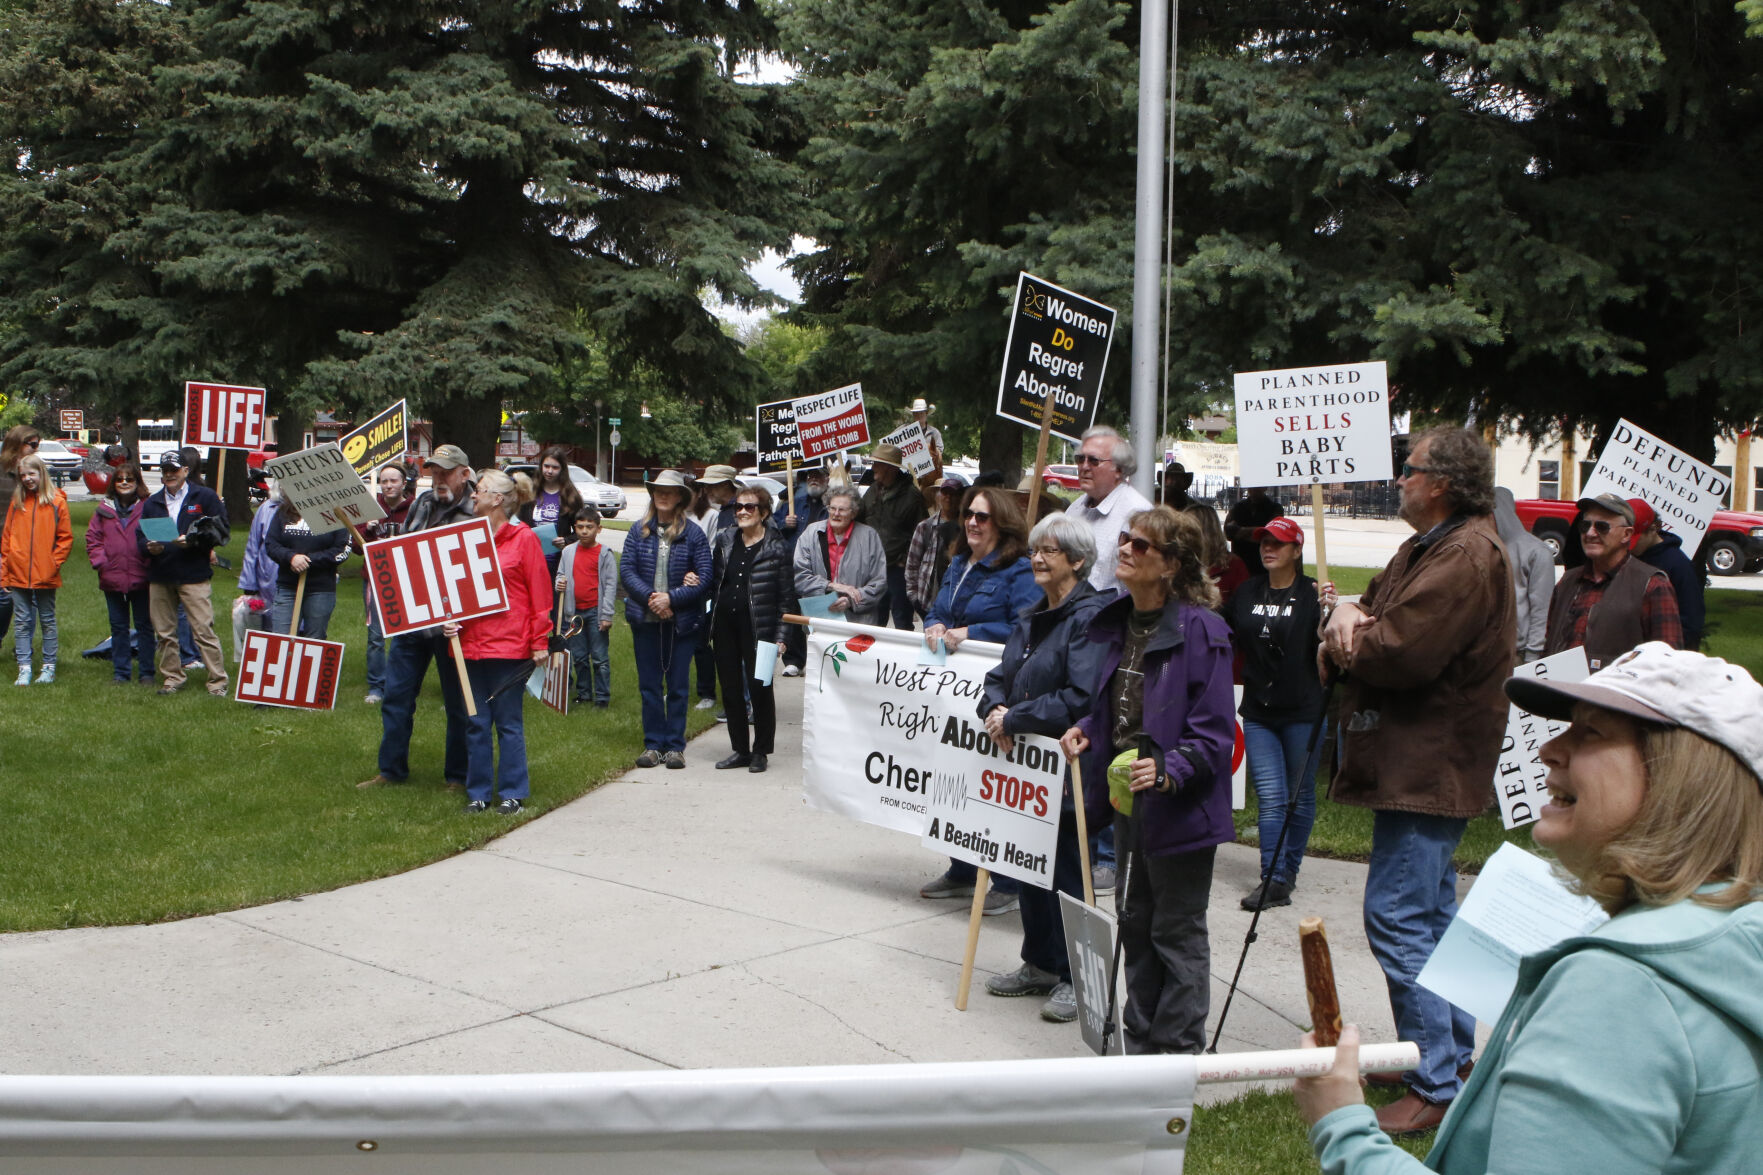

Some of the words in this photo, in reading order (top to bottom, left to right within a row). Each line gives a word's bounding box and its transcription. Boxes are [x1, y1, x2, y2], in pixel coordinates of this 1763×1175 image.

[1046, 295, 1107, 338] Women
[1052, 327, 1074, 351] Do
[1028, 342, 1084, 381] Regret
[1261, 370, 1361, 390] PLANNED
[796, 396, 836, 417] RESPECT
[839, 388, 860, 404] LIFE
[1014, 369, 1085, 412] Abortion
[1244, 390, 1380, 412] PARENTHOOD
[188, 388, 200, 441] CHOOSE
[200, 389, 262, 446] LIFE
[368, 411, 403, 450] SMILE!
[770, 422, 798, 435] Regr
[778, 408, 794, 420] Me
[801, 426, 822, 441] FROM
[823, 421, 838, 435] THE
[838, 413, 864, 430] WOMB
[1274, 412, 1351, 433] SELLS
[758, 447, 803, 462] Fatherh
[811, 442, 821, 453] TO
[823, 437, 837, 449] THE
[837, 431, 860, 446] TOMB
[901, 439, 924, 458] STOPS
[1281, 436, 1346, 455] BABY
[1613, 425, 1726, 497] DEFUND
[271, 448, 344, 480] DEFUND
[294, 471, 344, 492] PLANNED
[1276, 457, 1355, 478] PARTS
[1623, 456, 1698, 504] PLANNED
[295, 484, 367, 510] PARENTHOOD
[320, 503, 362, 526] NW
[1598, 465, 1706, 531] PARENTHOOD
[373, 548, 401, 627] CHOOSE
[391, 527, 501, 625] LIFE
[241, 635, 324, 704] LIFE
[317, 647, 337, 706] CHOOSE
[875, 658, 935, 692] West
[936, 670, 985, 700] Par
[879, 701, 941, 740] Righ
[1519, 710, 1549, 793] PLANNE
[864, 751, 932, 795] Cher
[1500, 734, 1533, 825] DEFU
[879, 796, 900, 808] FROM
[901, 801, 928, 815] CONCE
[979, 769, 1049, 818] STOPS
[928, 817, 940, 839] A
[944, 821, 999, 863] Beating
[1003, 841, 1048, 875] Heart
